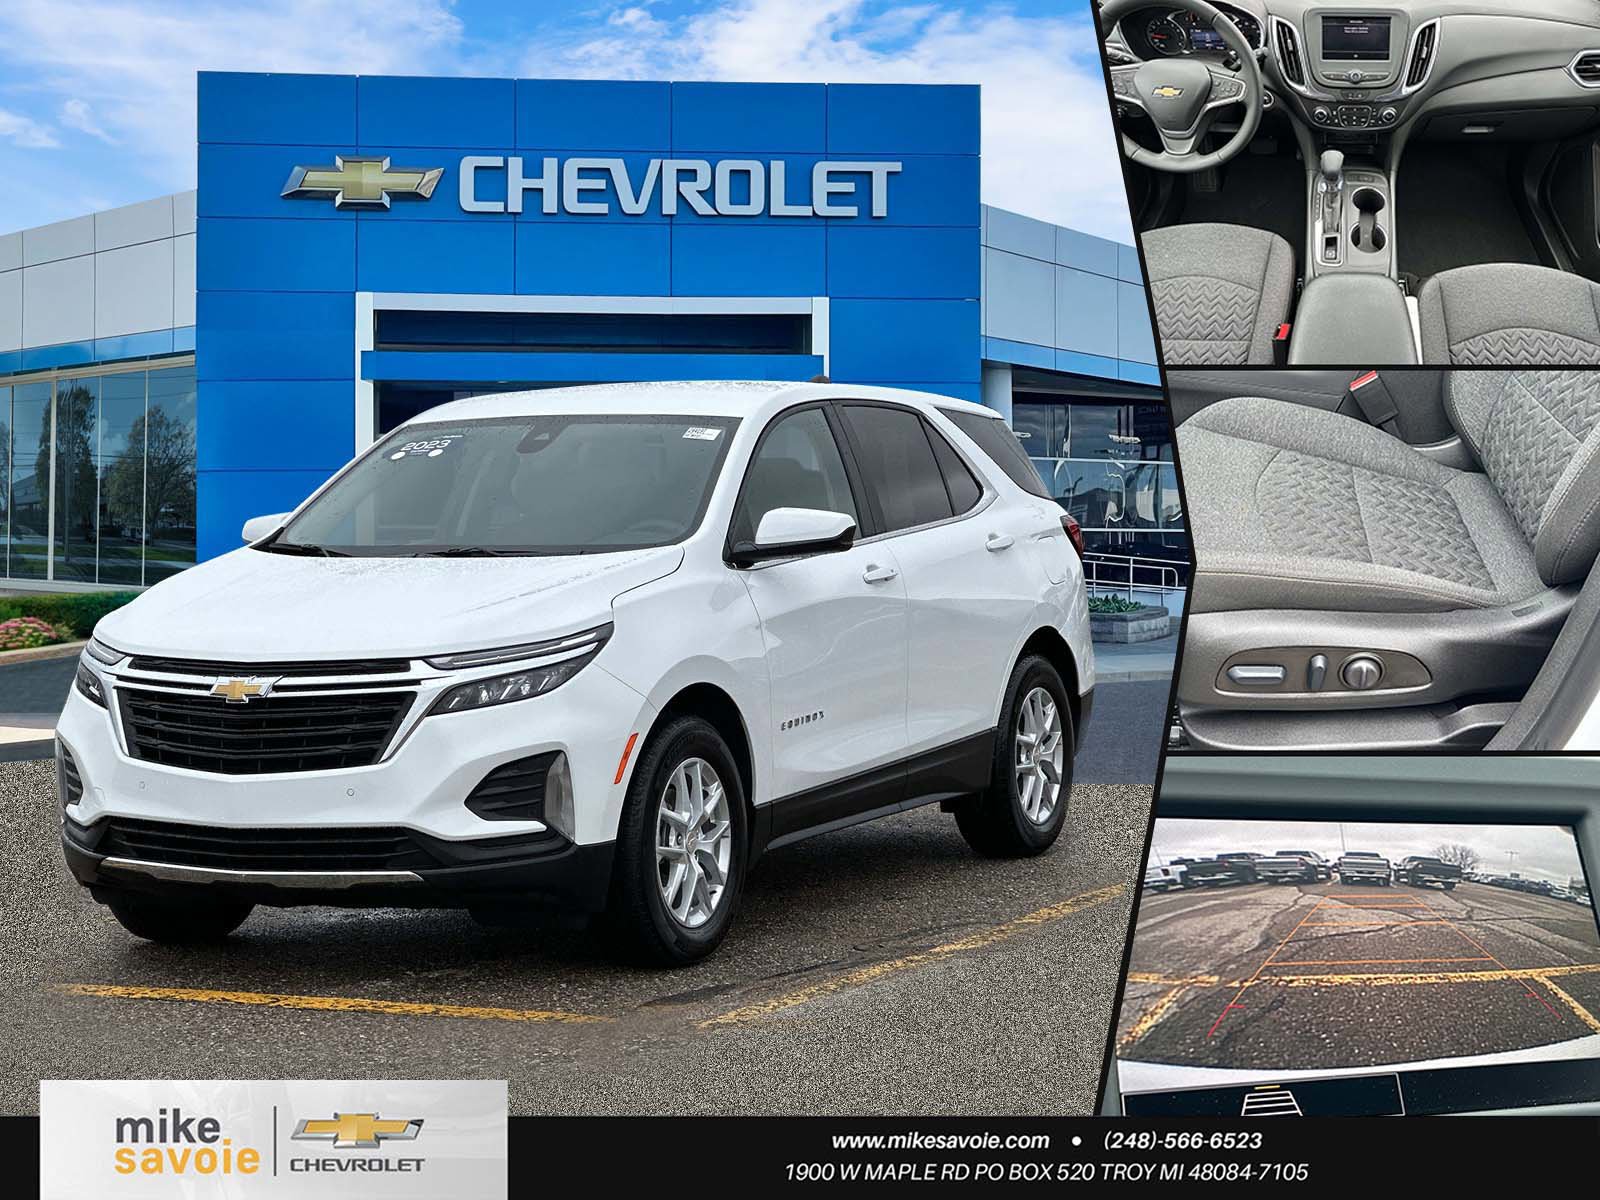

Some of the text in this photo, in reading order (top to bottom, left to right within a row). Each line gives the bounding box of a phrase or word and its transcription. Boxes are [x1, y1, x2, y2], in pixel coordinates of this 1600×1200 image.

[459, 156, 902, 218] CHEVROLET
[401, 440, 451, 451] 2023
[781, 711, 825, 731] EQUINOX
